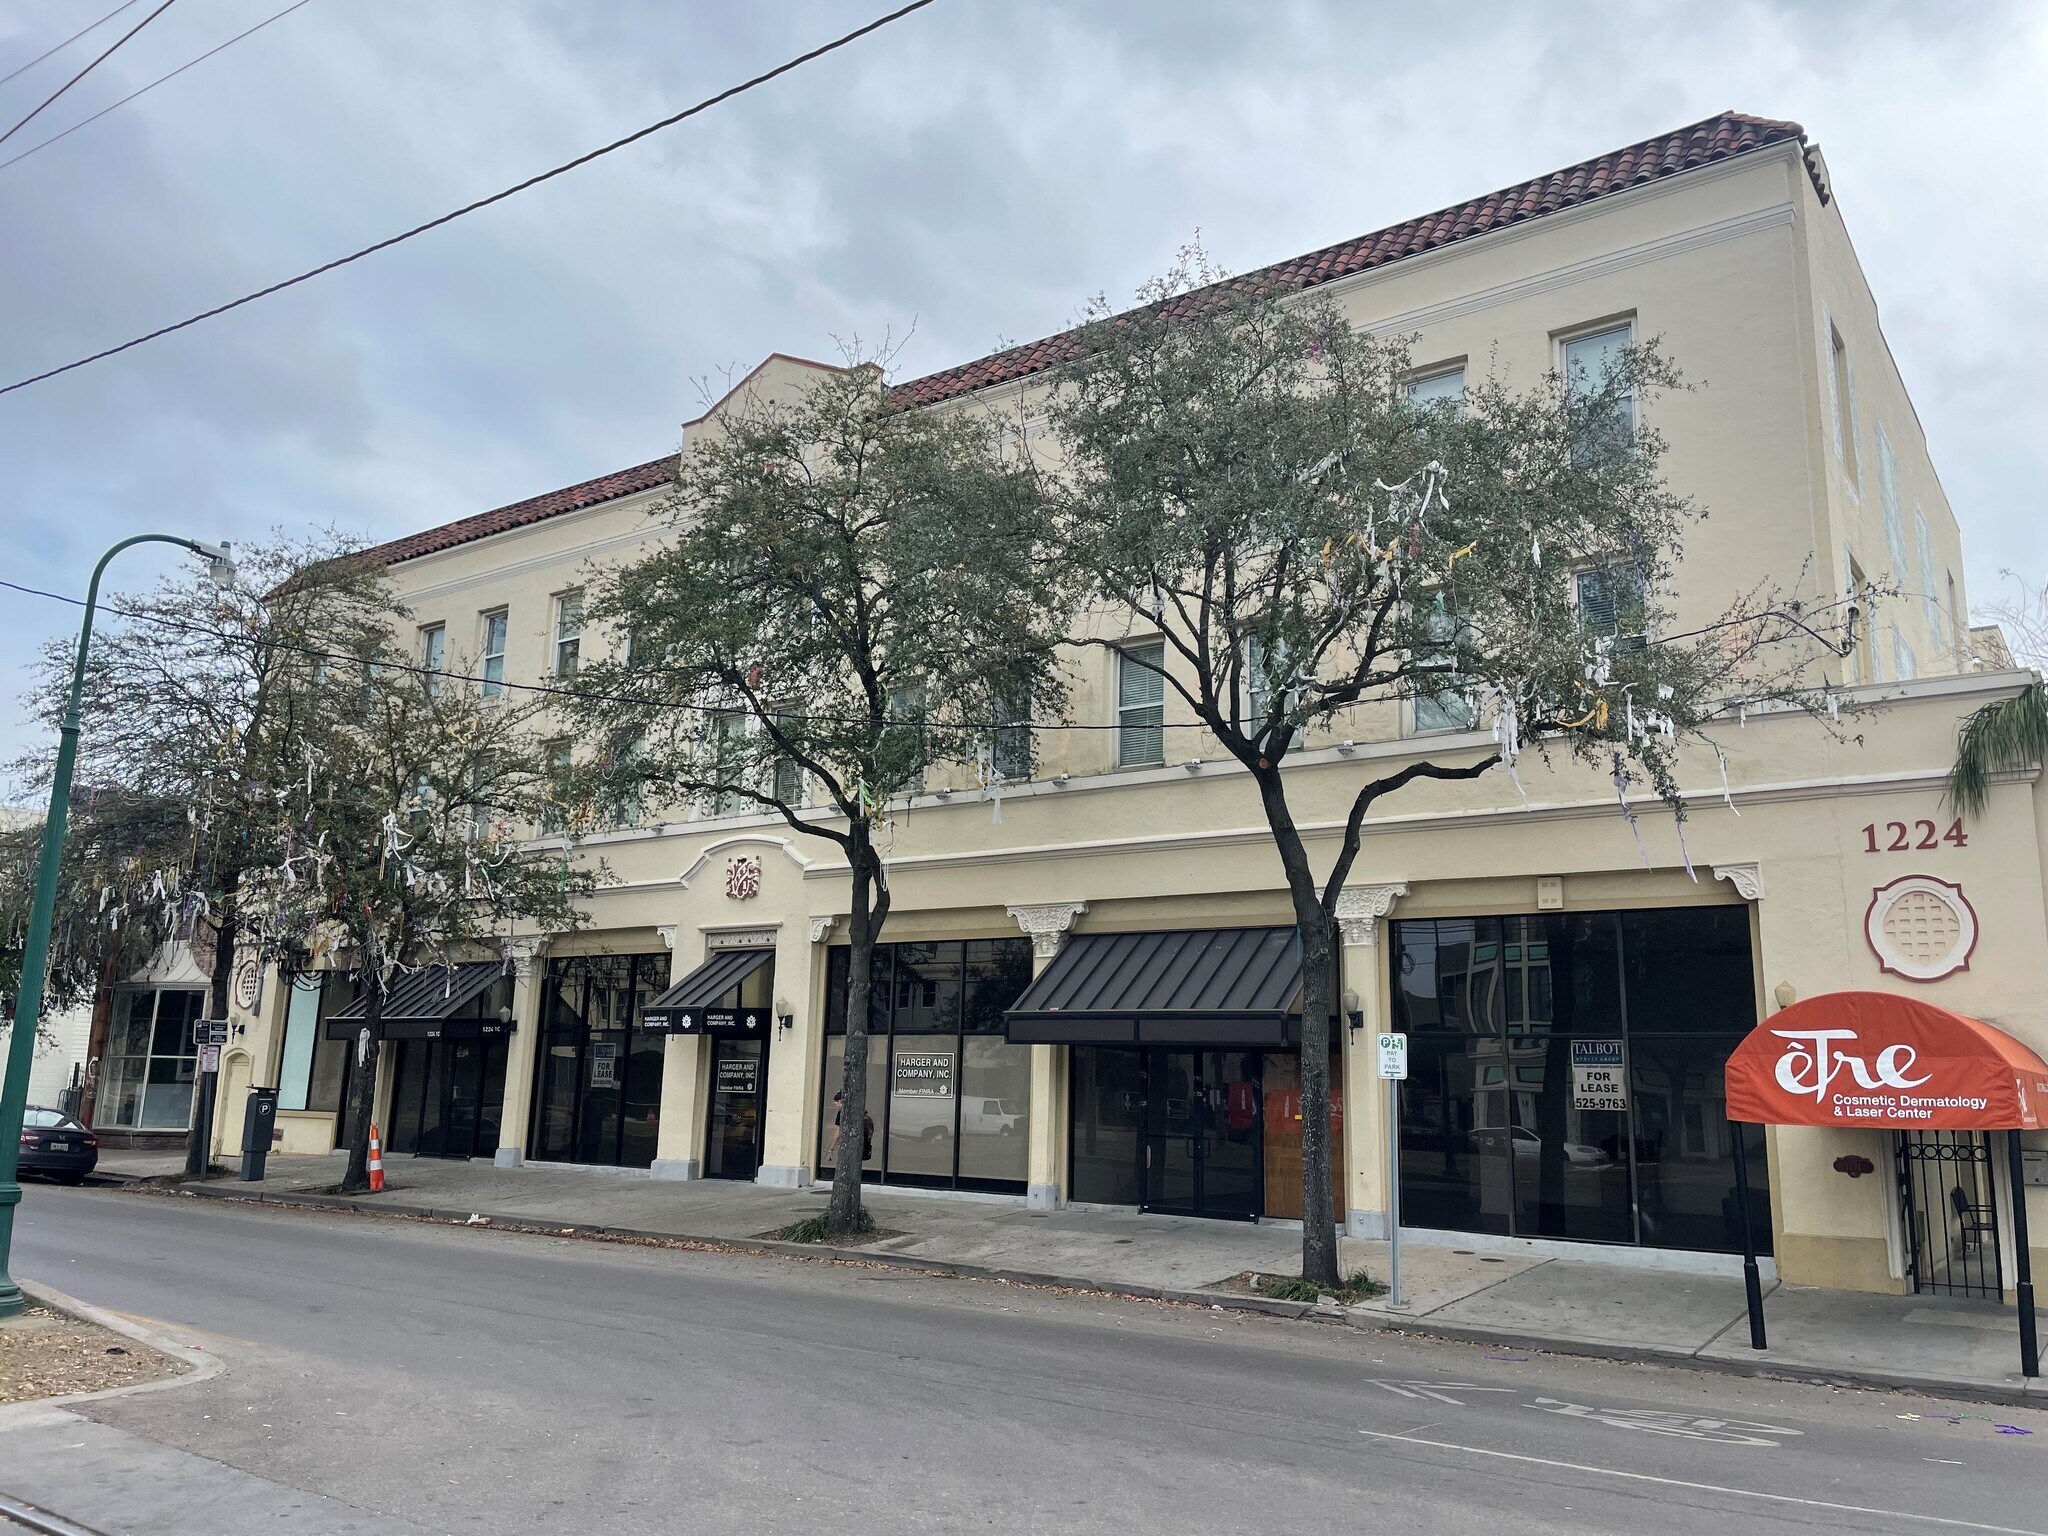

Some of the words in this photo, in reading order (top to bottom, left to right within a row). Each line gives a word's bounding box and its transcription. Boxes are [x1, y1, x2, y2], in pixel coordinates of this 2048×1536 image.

[1861, 817, 1968, 853] 1224
[1572, 1042, 1621, 1054] TALBOT
[900, 1058, 931, 1066] HARGER
[932, 1058, 949, 1066] AND
[898, 1069, 936, 1079] COMPANY,
[936, 1070, 951, 1078] INC.
[1587, 1072, 1610, 1080] FOR
[1581, 1084, 1618, 1092] LEASE
[1576, 1098, 1626, 1108] 525-9763
[1832, 1094, 1896, 1106] Cosmetic
[1900, 1094, 1988, 1109] Dermatology
[1834, 1106, 1843, 1117] &
[1846, 1106, 1884, 1118] Laser
[1886, 1107, 1933, 1118] Center
